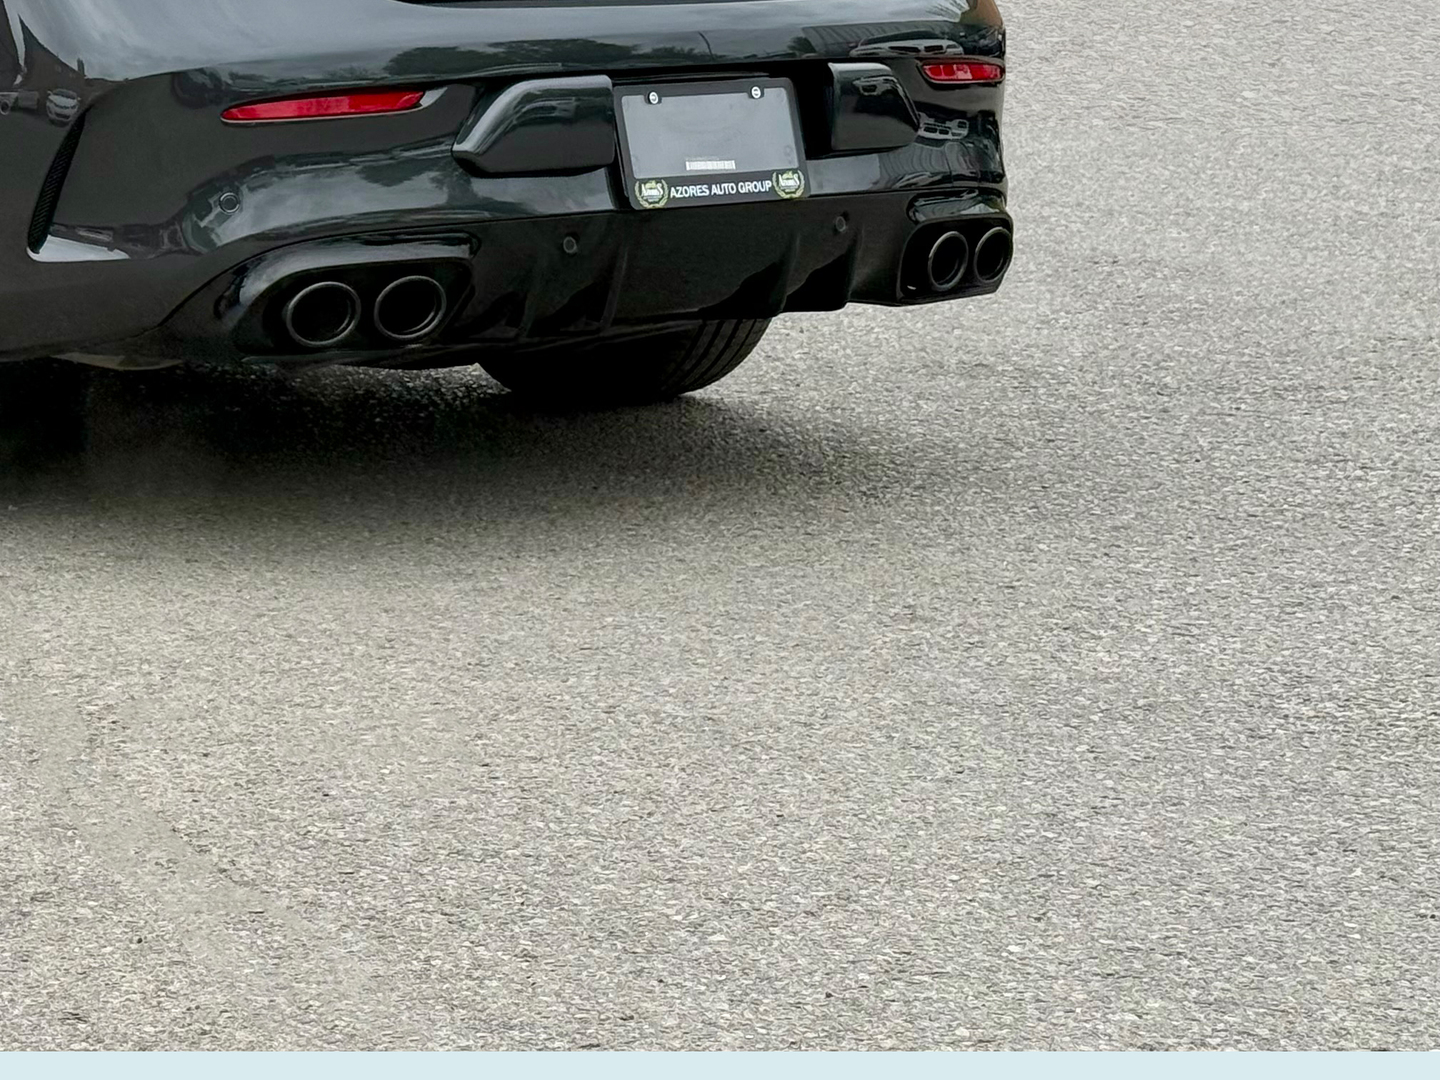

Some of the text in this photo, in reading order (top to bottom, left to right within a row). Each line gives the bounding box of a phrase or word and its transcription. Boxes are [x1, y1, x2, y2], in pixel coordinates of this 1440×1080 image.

[669, 184, 710, 199] AZORES
[711, 182, 737, 196] AUTO
[737, 180, 773, 194] GROUP
